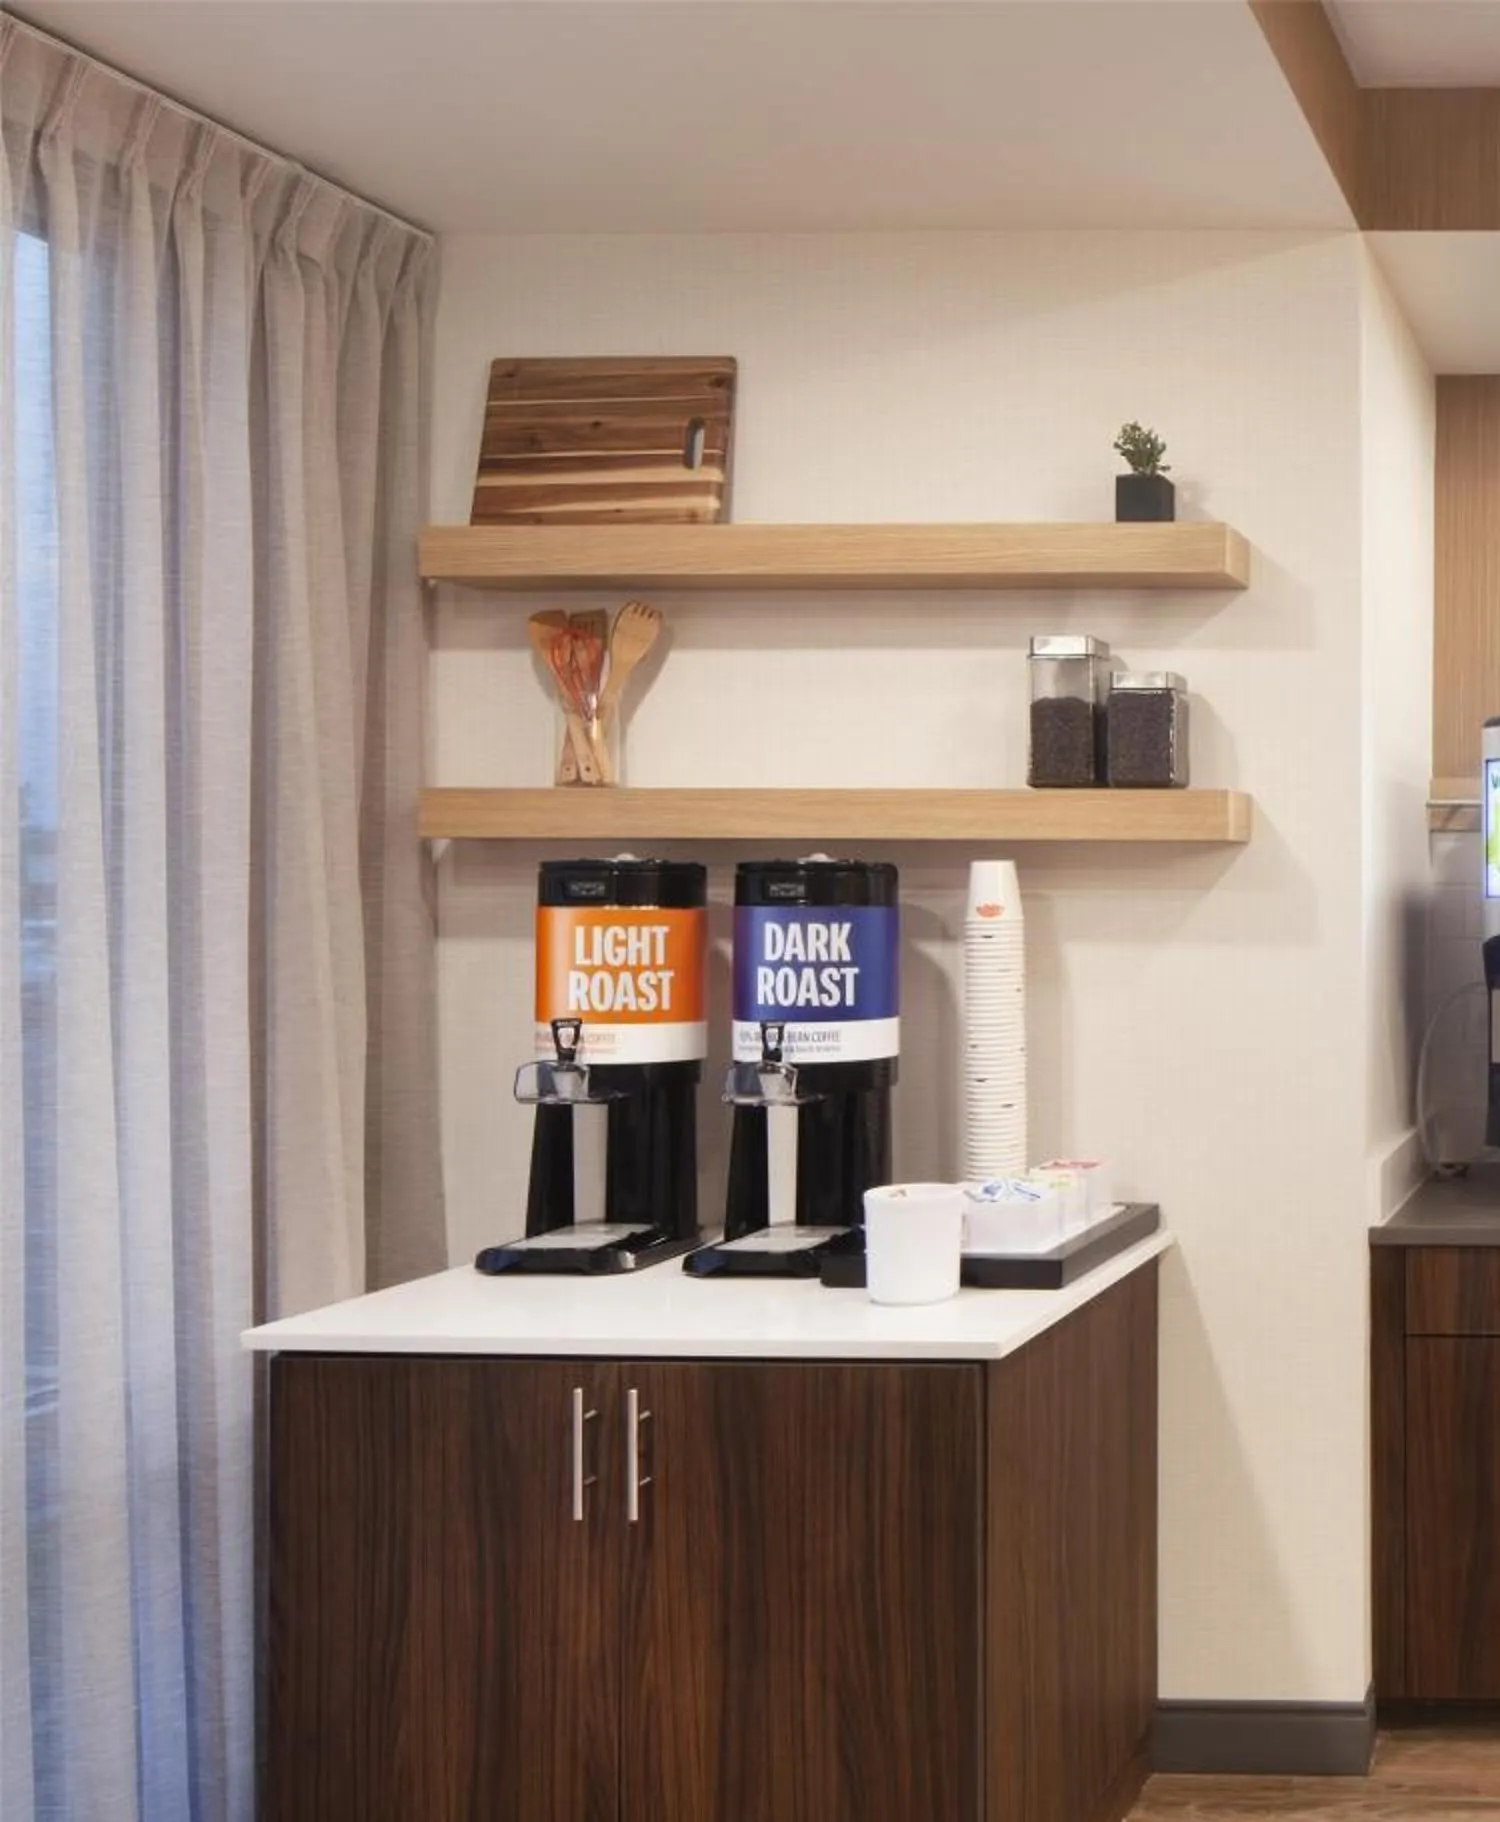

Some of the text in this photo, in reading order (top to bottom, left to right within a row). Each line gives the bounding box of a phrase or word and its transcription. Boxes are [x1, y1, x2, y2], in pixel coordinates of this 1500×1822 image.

[574, 925, 670, 966] LIGHT
[764, 921, 852, 962] DARK
[568, 970, 675, 1012] ROAST
[757, 966, 860, 1008] ROAST
